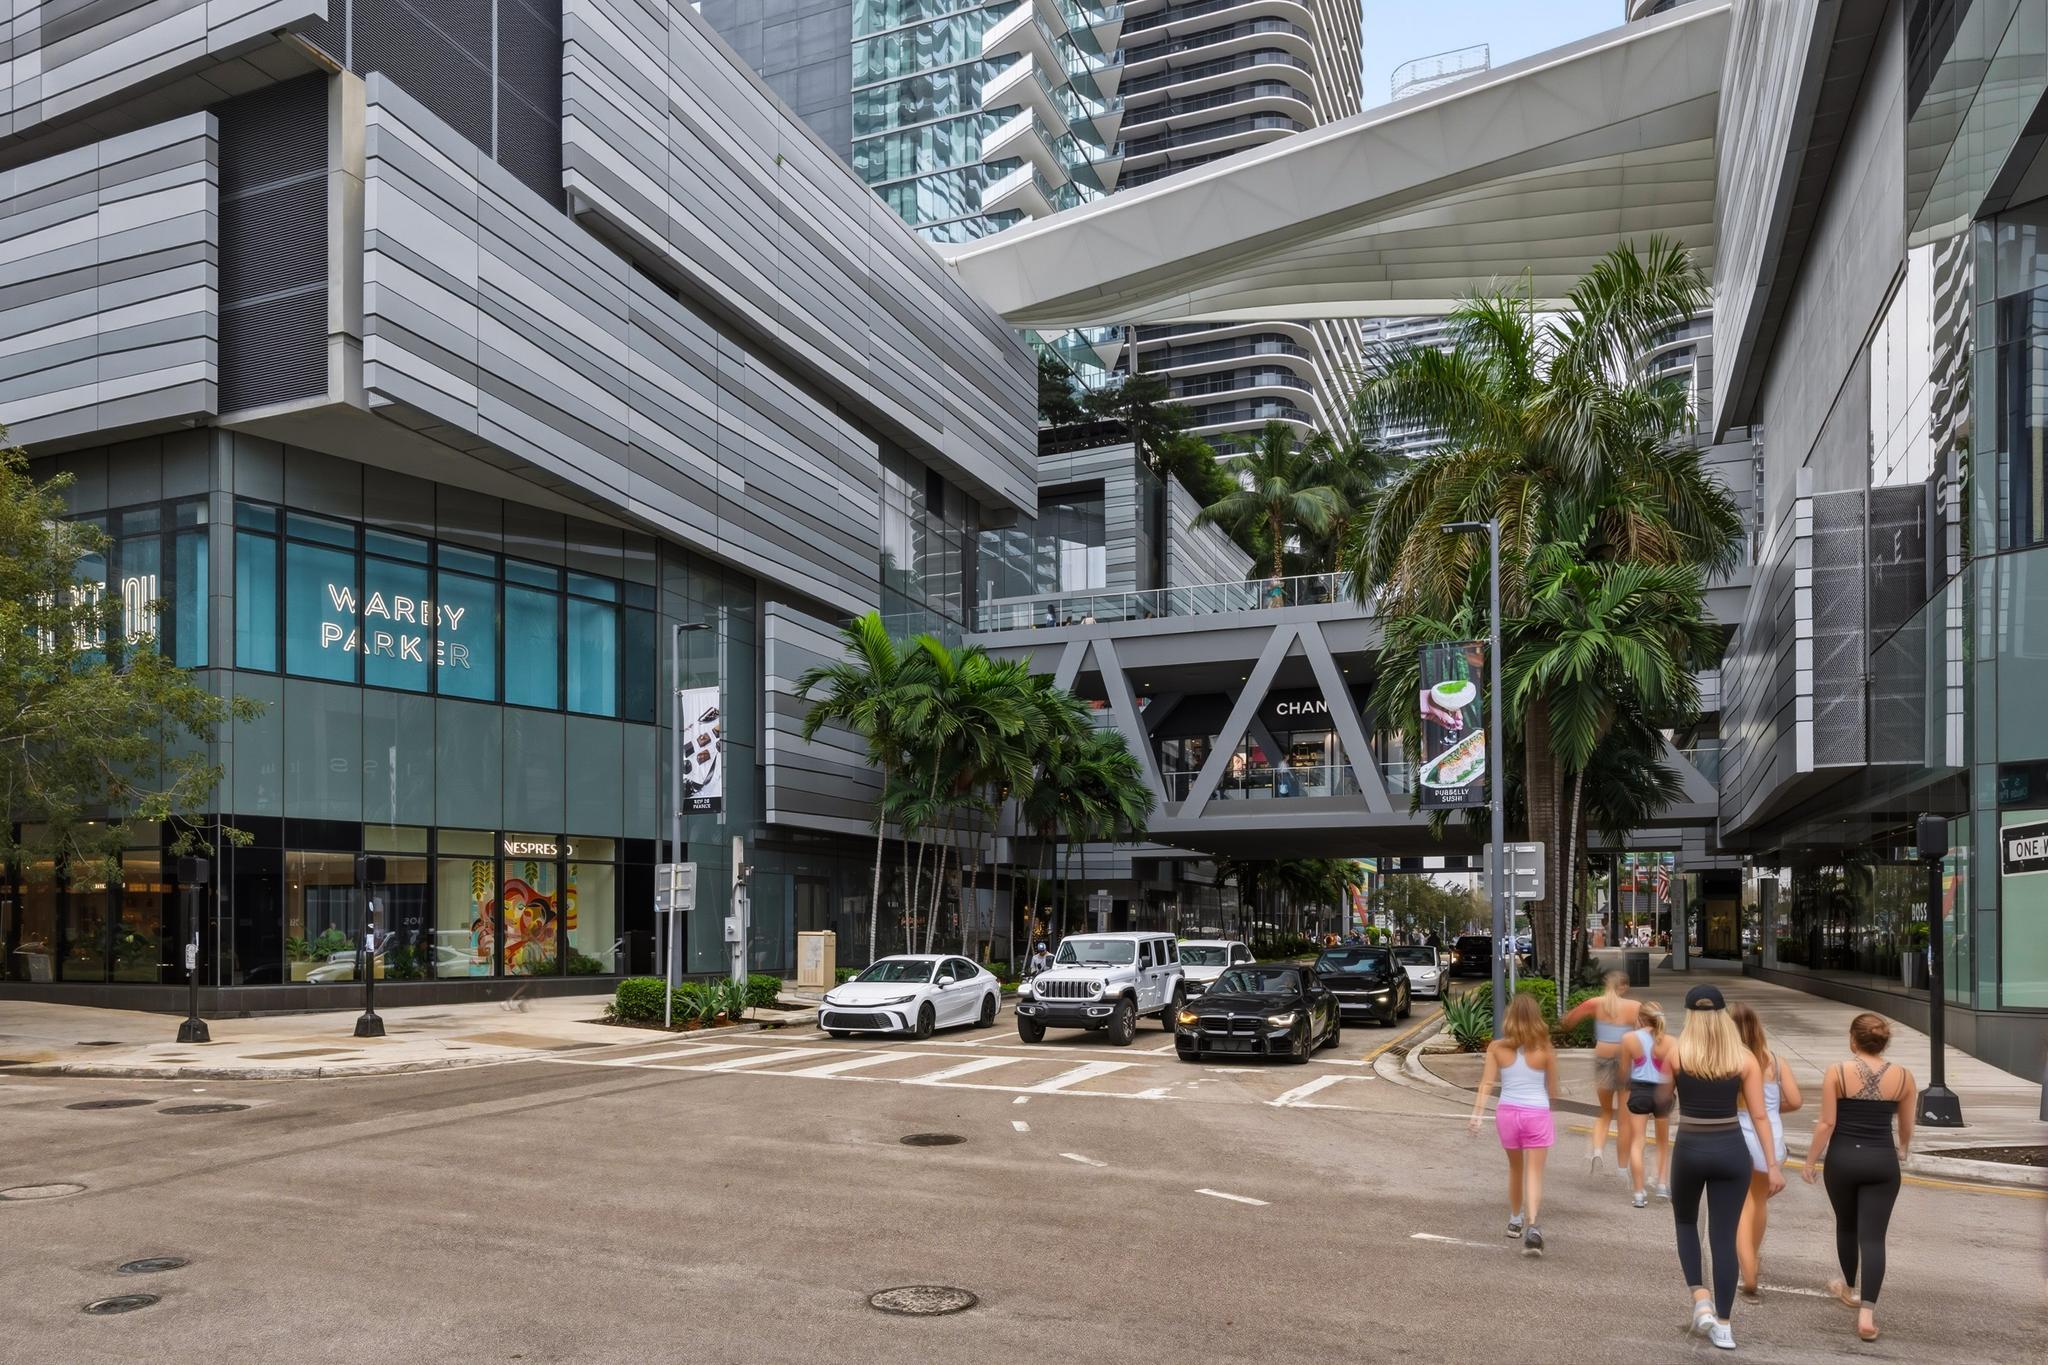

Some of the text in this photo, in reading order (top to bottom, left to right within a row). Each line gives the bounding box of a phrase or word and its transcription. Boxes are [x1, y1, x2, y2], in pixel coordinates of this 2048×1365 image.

[121, 574, 156, 645] OU
[328, 583, 465, 631] WARBY
[1276, 700, 1328, 716] CHAN
[1441, 795, 1463, 803] SUSHI
[504, 839, 573, 856] NESPRESO
[2016, 839, 2039, 858] ONE
[1911, 902, 1928, 922] BOSS
